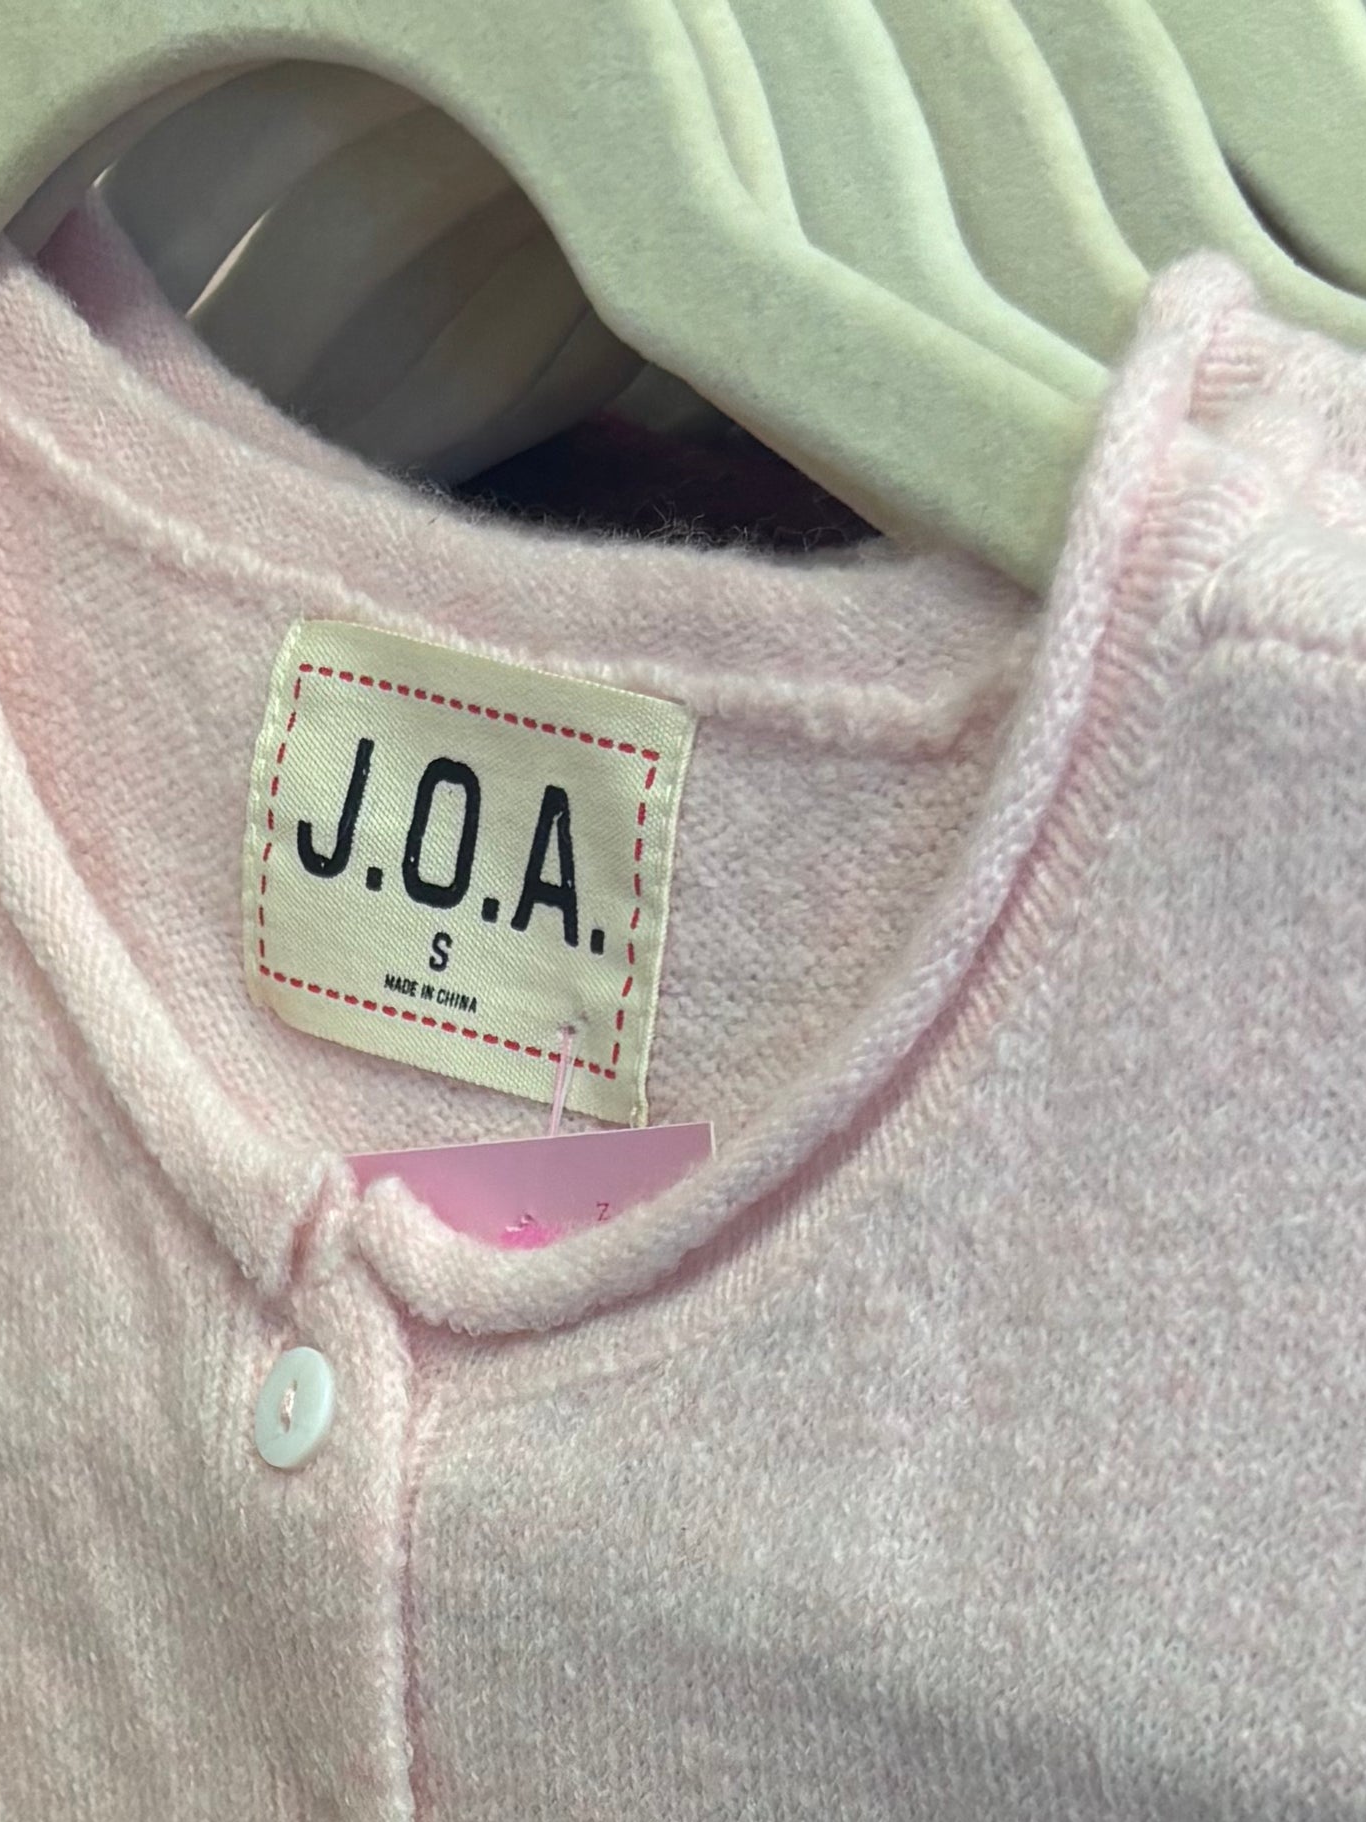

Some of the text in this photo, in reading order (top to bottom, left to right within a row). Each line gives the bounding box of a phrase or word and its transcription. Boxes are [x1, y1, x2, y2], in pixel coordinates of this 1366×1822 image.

[296, 737, 606, 955] J.O.A.
[429, 931, 453, 972] S
[383, 973, 478, 1014] MADE IN CHINA
